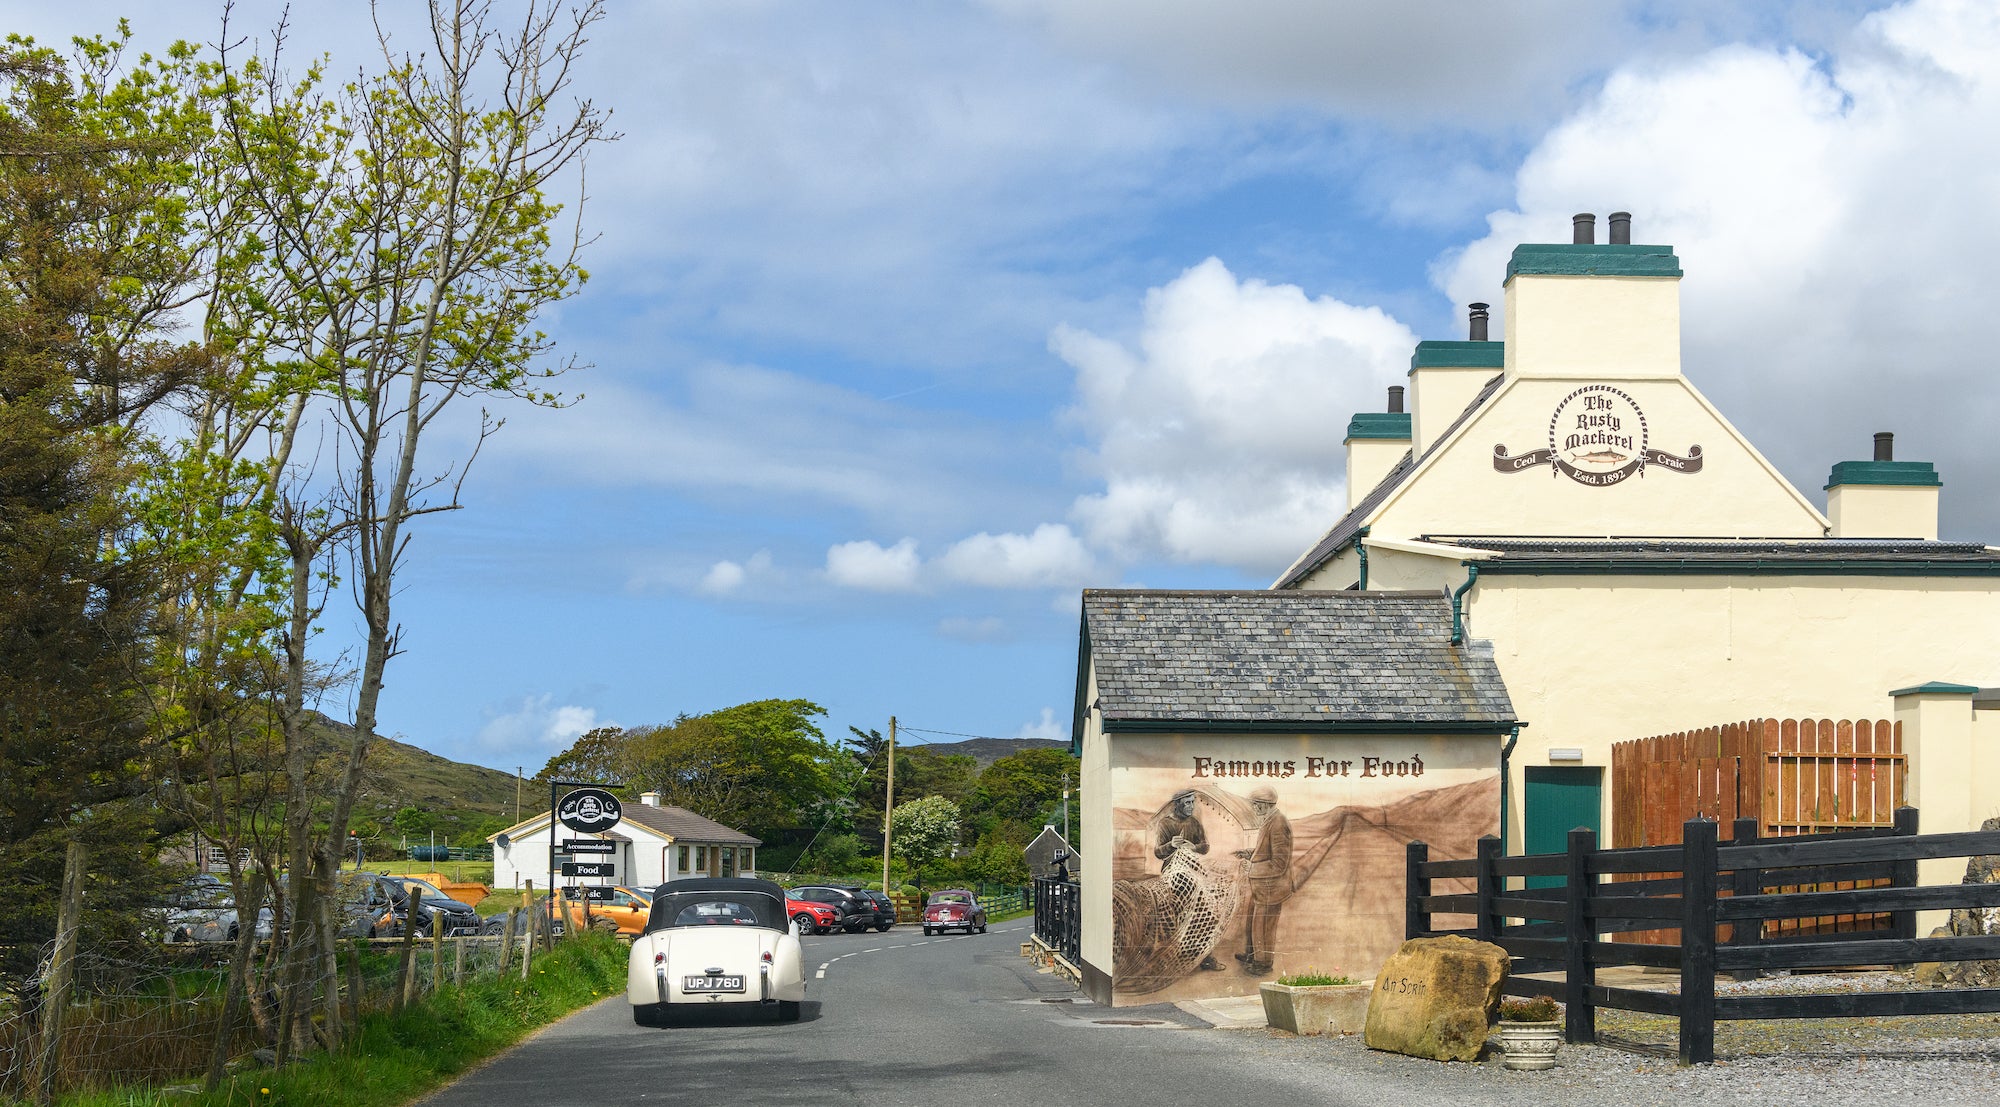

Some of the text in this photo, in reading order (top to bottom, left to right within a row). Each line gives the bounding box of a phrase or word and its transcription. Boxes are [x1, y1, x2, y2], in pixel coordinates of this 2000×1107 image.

[1584, 395, 1613, 411] The
[1576, 413, 1621, 431] Rusty
[1564, 430, 1633, 451] Mackerel
[1513, 453, 1536, 469] Ceol
[1656, 453, 1685, 469] Craic
[1572, 469, 1626, 485] Estd. 1892
[1191, 753, 1424, 779] Famous For Food
[566, 843, 613, 851] Accommodation
[577, 865, 599, 874] Food
[688, 978, 740, 988] UPJ 760
[1382, 976, 1396, 992] An
